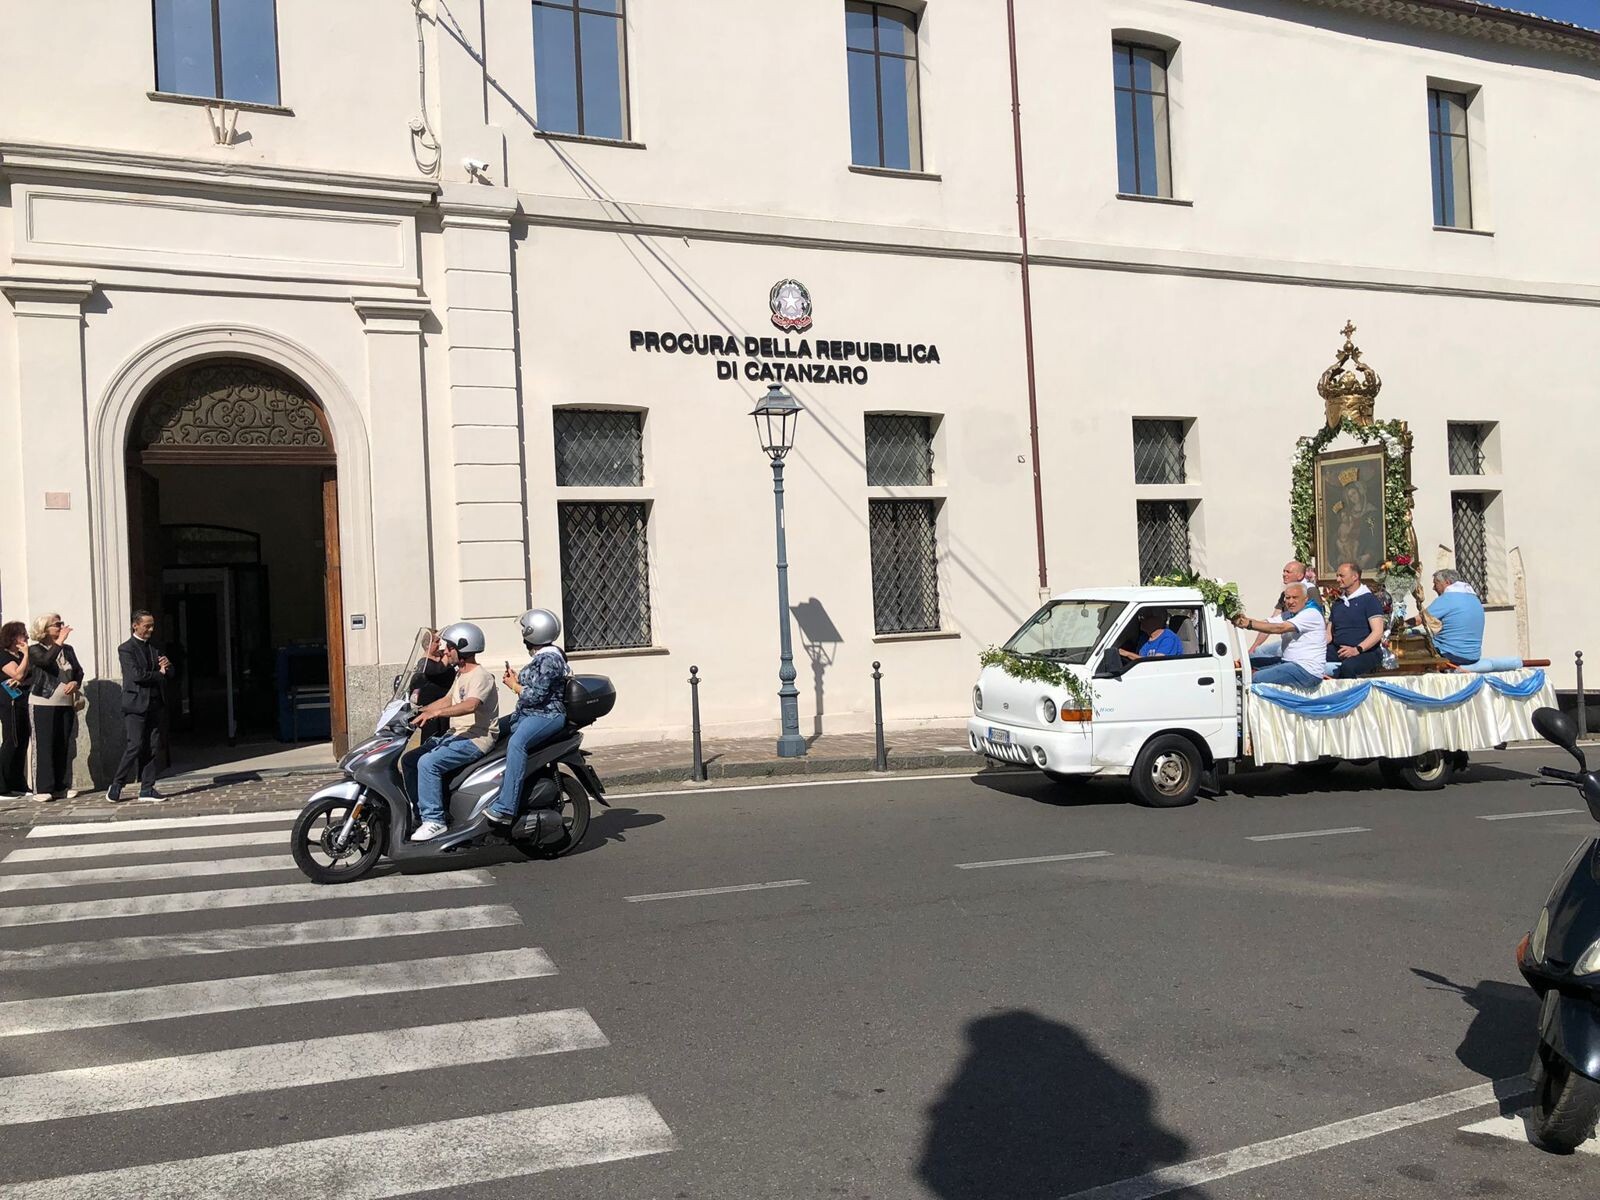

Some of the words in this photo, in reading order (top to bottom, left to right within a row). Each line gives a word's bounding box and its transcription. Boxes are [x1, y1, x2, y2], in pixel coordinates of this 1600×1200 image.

[629, 330, 740, 357] PROCURA
[744, 336, 813, 359] DELLA
[815, 339, 941, 364] REPUBBLICA
[716, 360, 738, 381] DI
[744, 361, 869, 385] CATANZARO
